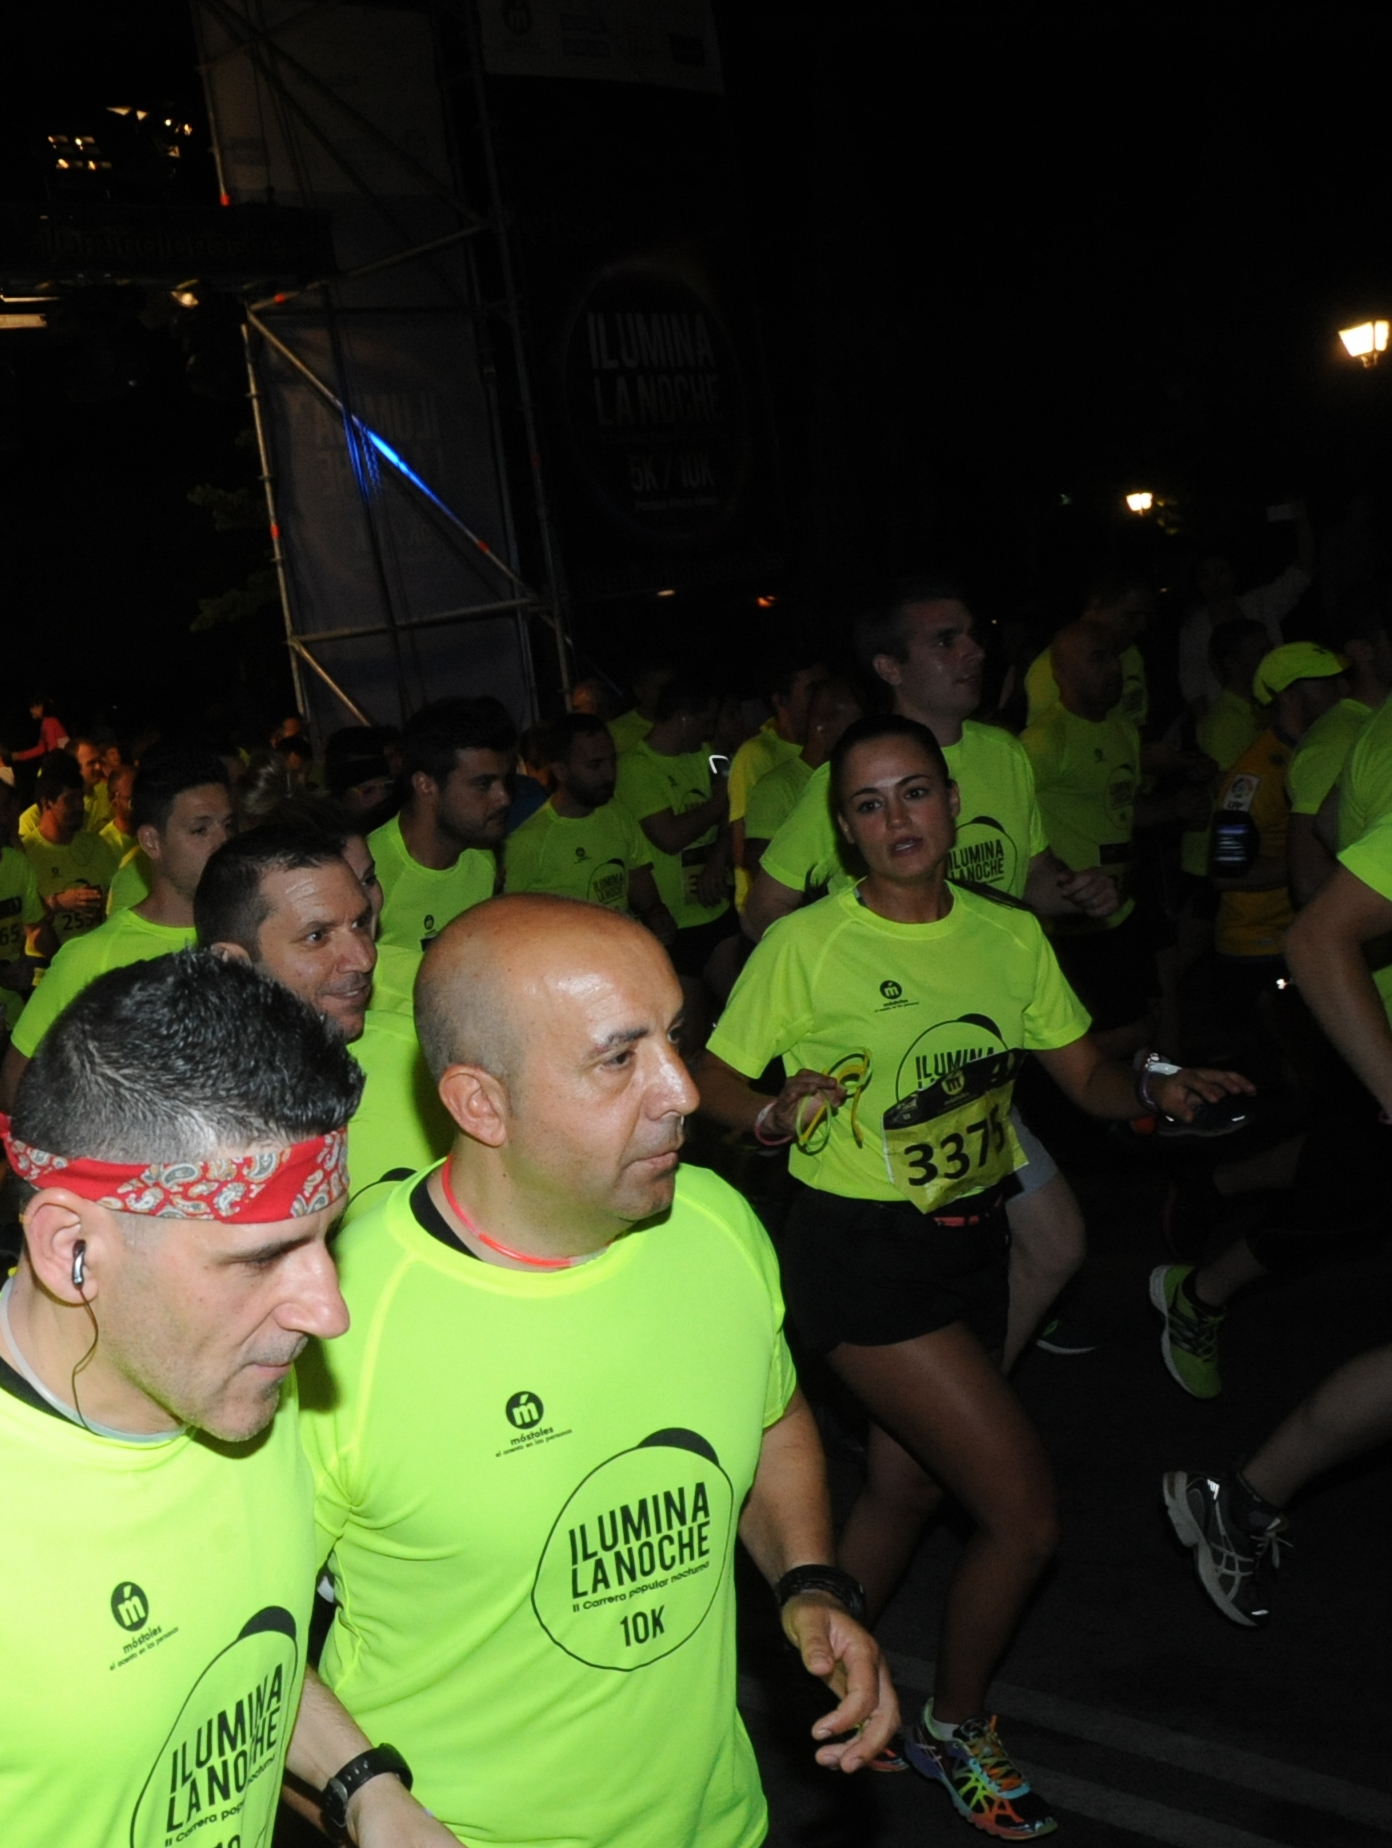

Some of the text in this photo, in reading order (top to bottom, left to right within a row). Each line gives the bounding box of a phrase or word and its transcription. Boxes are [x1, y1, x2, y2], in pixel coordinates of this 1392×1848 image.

[587, 312, 716, 369] ILUMINA
[948, 839, 1004, 870] ILUMINA
[569, 1481, 710, 1567] ILUMINA
[583, 1593, 626, 1610] Carrera
[629, 1578, 669, 1600] popular
[620, 1604, 665, 1647] 10K
[171, 1663, 283, 1795] ILUMINA
[176, 1813, 218, 1842] Carrera
